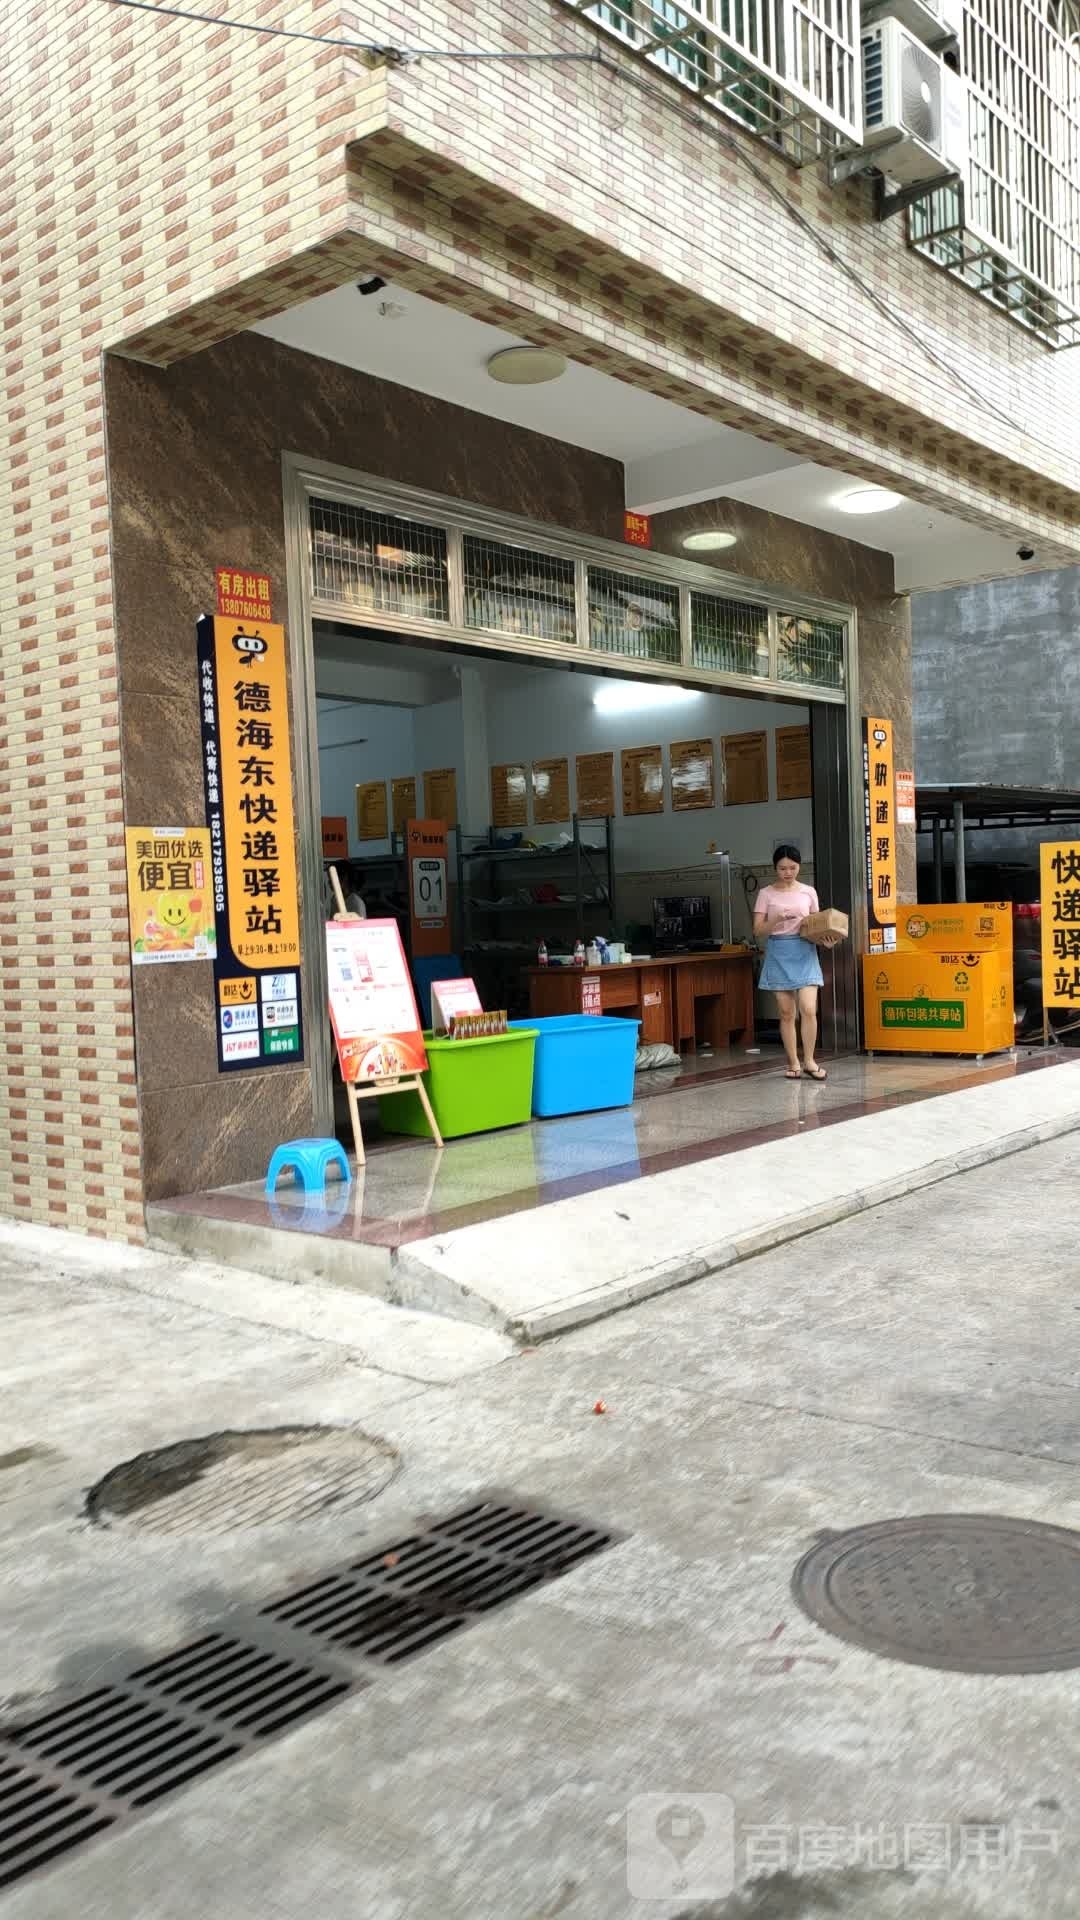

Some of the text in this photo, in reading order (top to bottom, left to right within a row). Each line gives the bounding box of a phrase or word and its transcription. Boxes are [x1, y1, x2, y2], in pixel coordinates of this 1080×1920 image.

[218, 571, 270, 601] 有房出租
[233, 680, 281, 935] 德海东快递驿站
[874, 762, 891, 899] 快递驿站
[136, 840, 204, 859] 美团优选
[138, 861, 193, 892] 便宜
[419, 876, 443, 901] 01
[884, 1007, 962, 1023] 循环包装共享站
